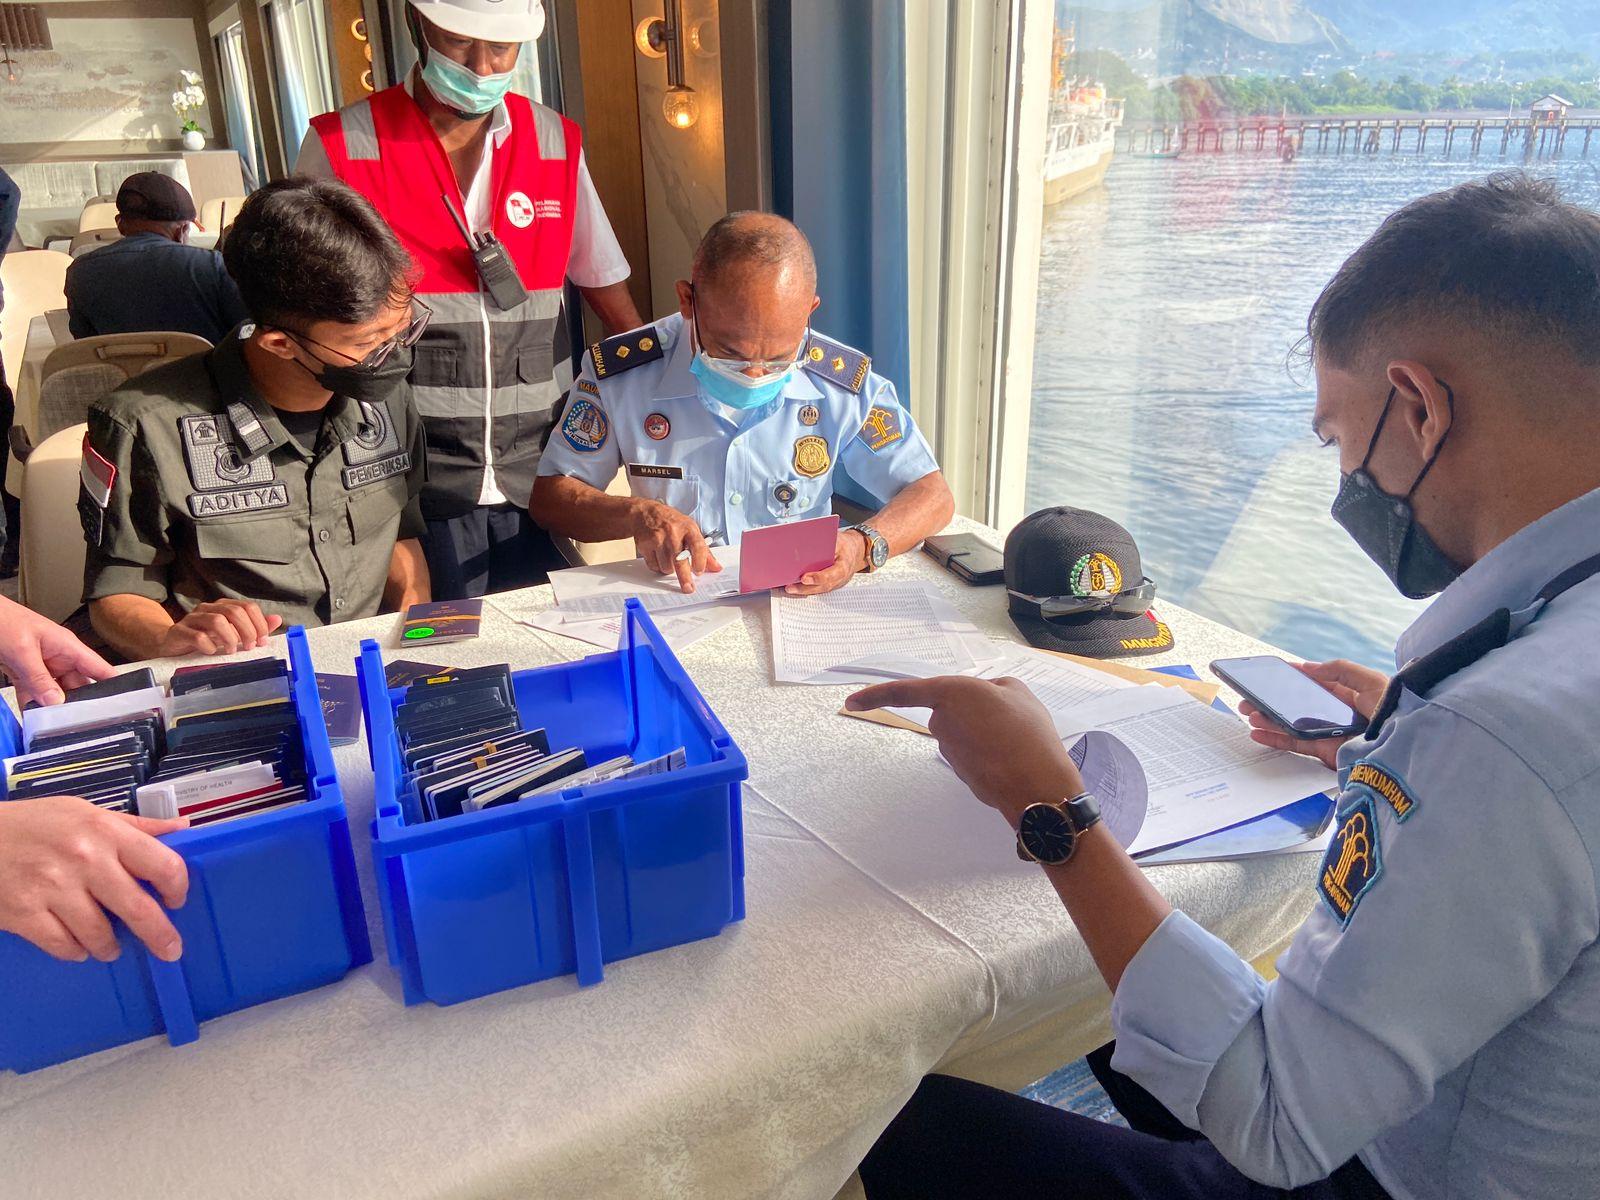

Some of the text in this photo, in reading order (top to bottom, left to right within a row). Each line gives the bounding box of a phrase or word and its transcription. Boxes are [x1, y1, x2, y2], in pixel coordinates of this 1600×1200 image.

[349, 454, 410, 485] PEMERIKSA
[641, 467, 672, 476] MARSEL
[199, 488, 284, 513] ADITYA
